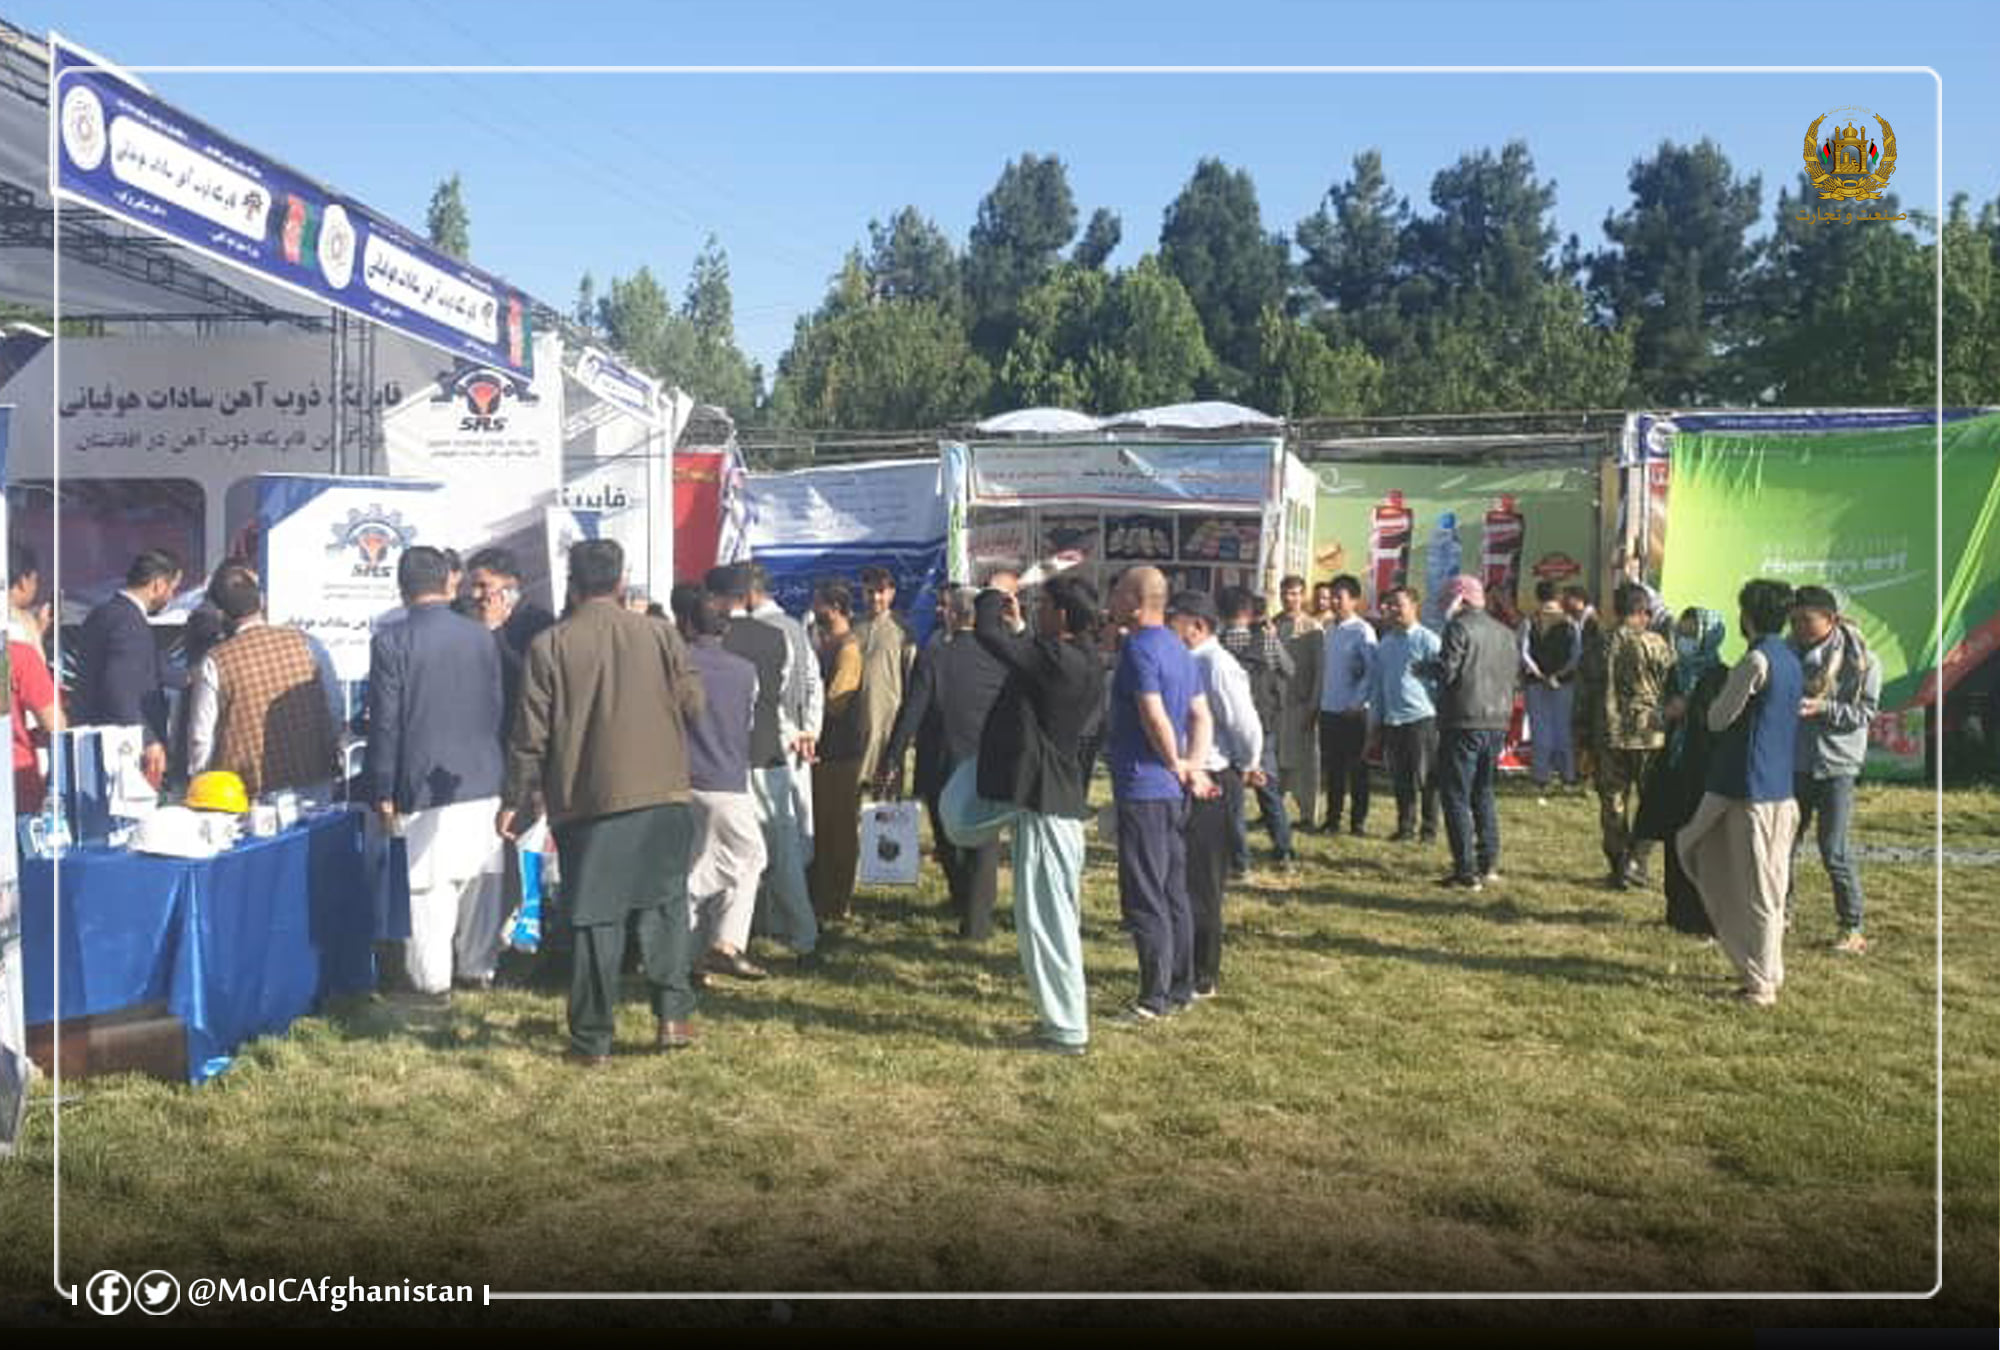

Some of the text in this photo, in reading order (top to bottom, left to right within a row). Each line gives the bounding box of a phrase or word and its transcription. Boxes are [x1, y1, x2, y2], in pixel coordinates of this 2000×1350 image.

[147, 386, 213, 409] سادات
[220, 379, 268, 416] آهن
[272, 380, 321, 416] ذوب
